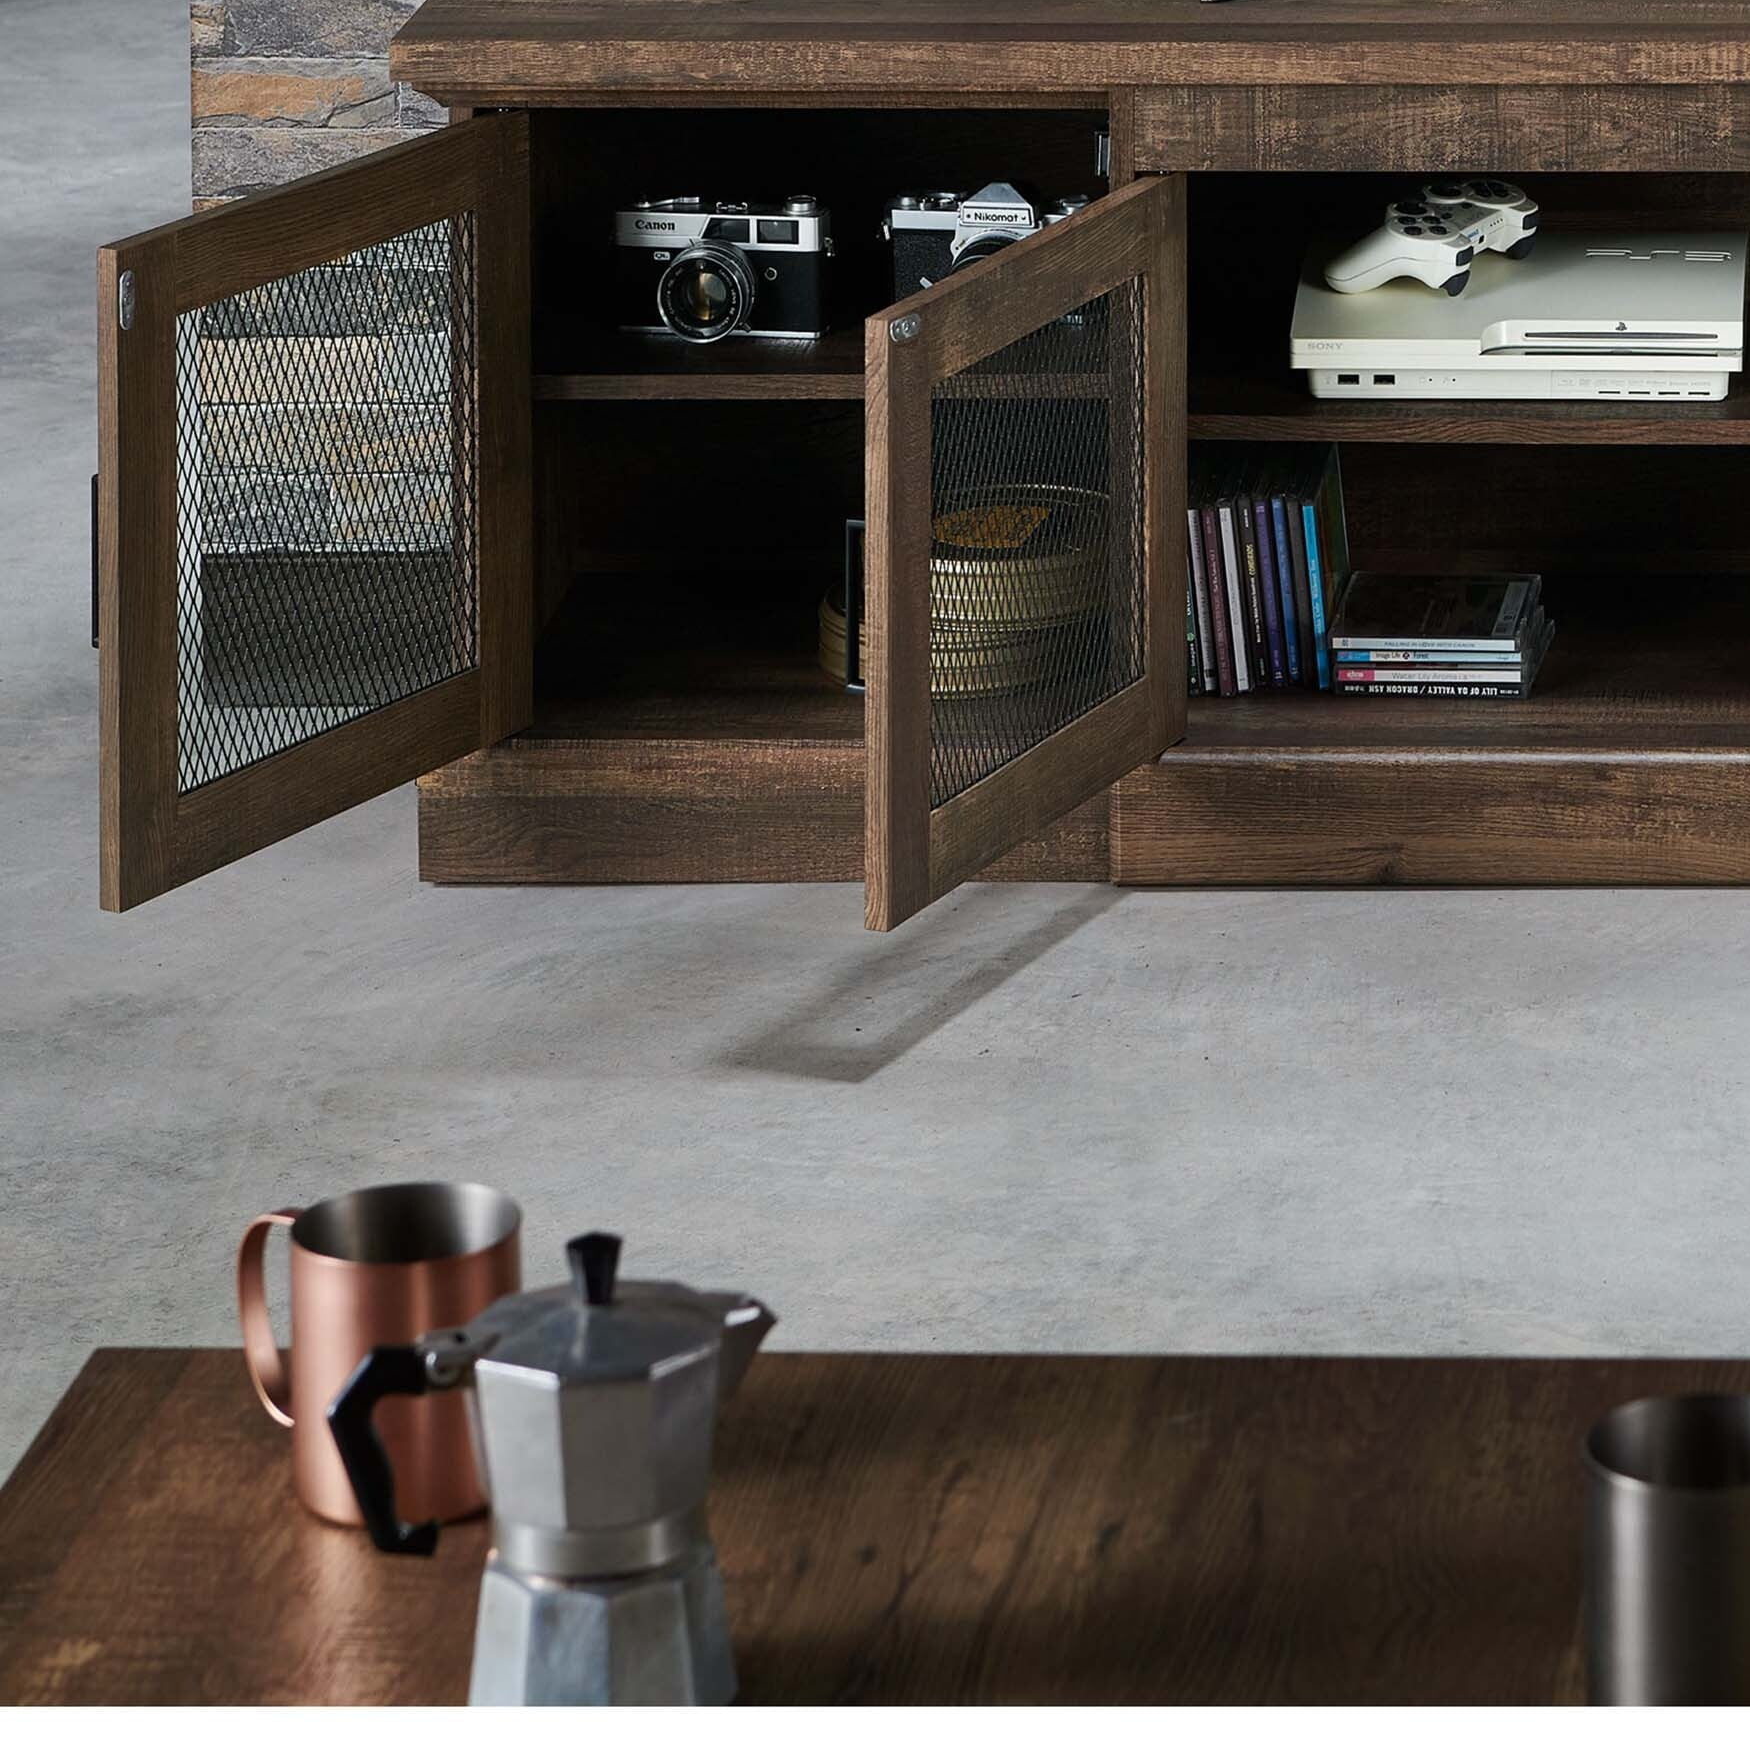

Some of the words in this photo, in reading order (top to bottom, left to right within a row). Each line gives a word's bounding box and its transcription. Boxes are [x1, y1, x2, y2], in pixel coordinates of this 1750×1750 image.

[974, 212, 1018, 222] Nikomat
[635, 219, 675, 230] Canon
[1427, 685, 1455, 694] VALLEY
[1482, 687, 1498, 695] LILY
